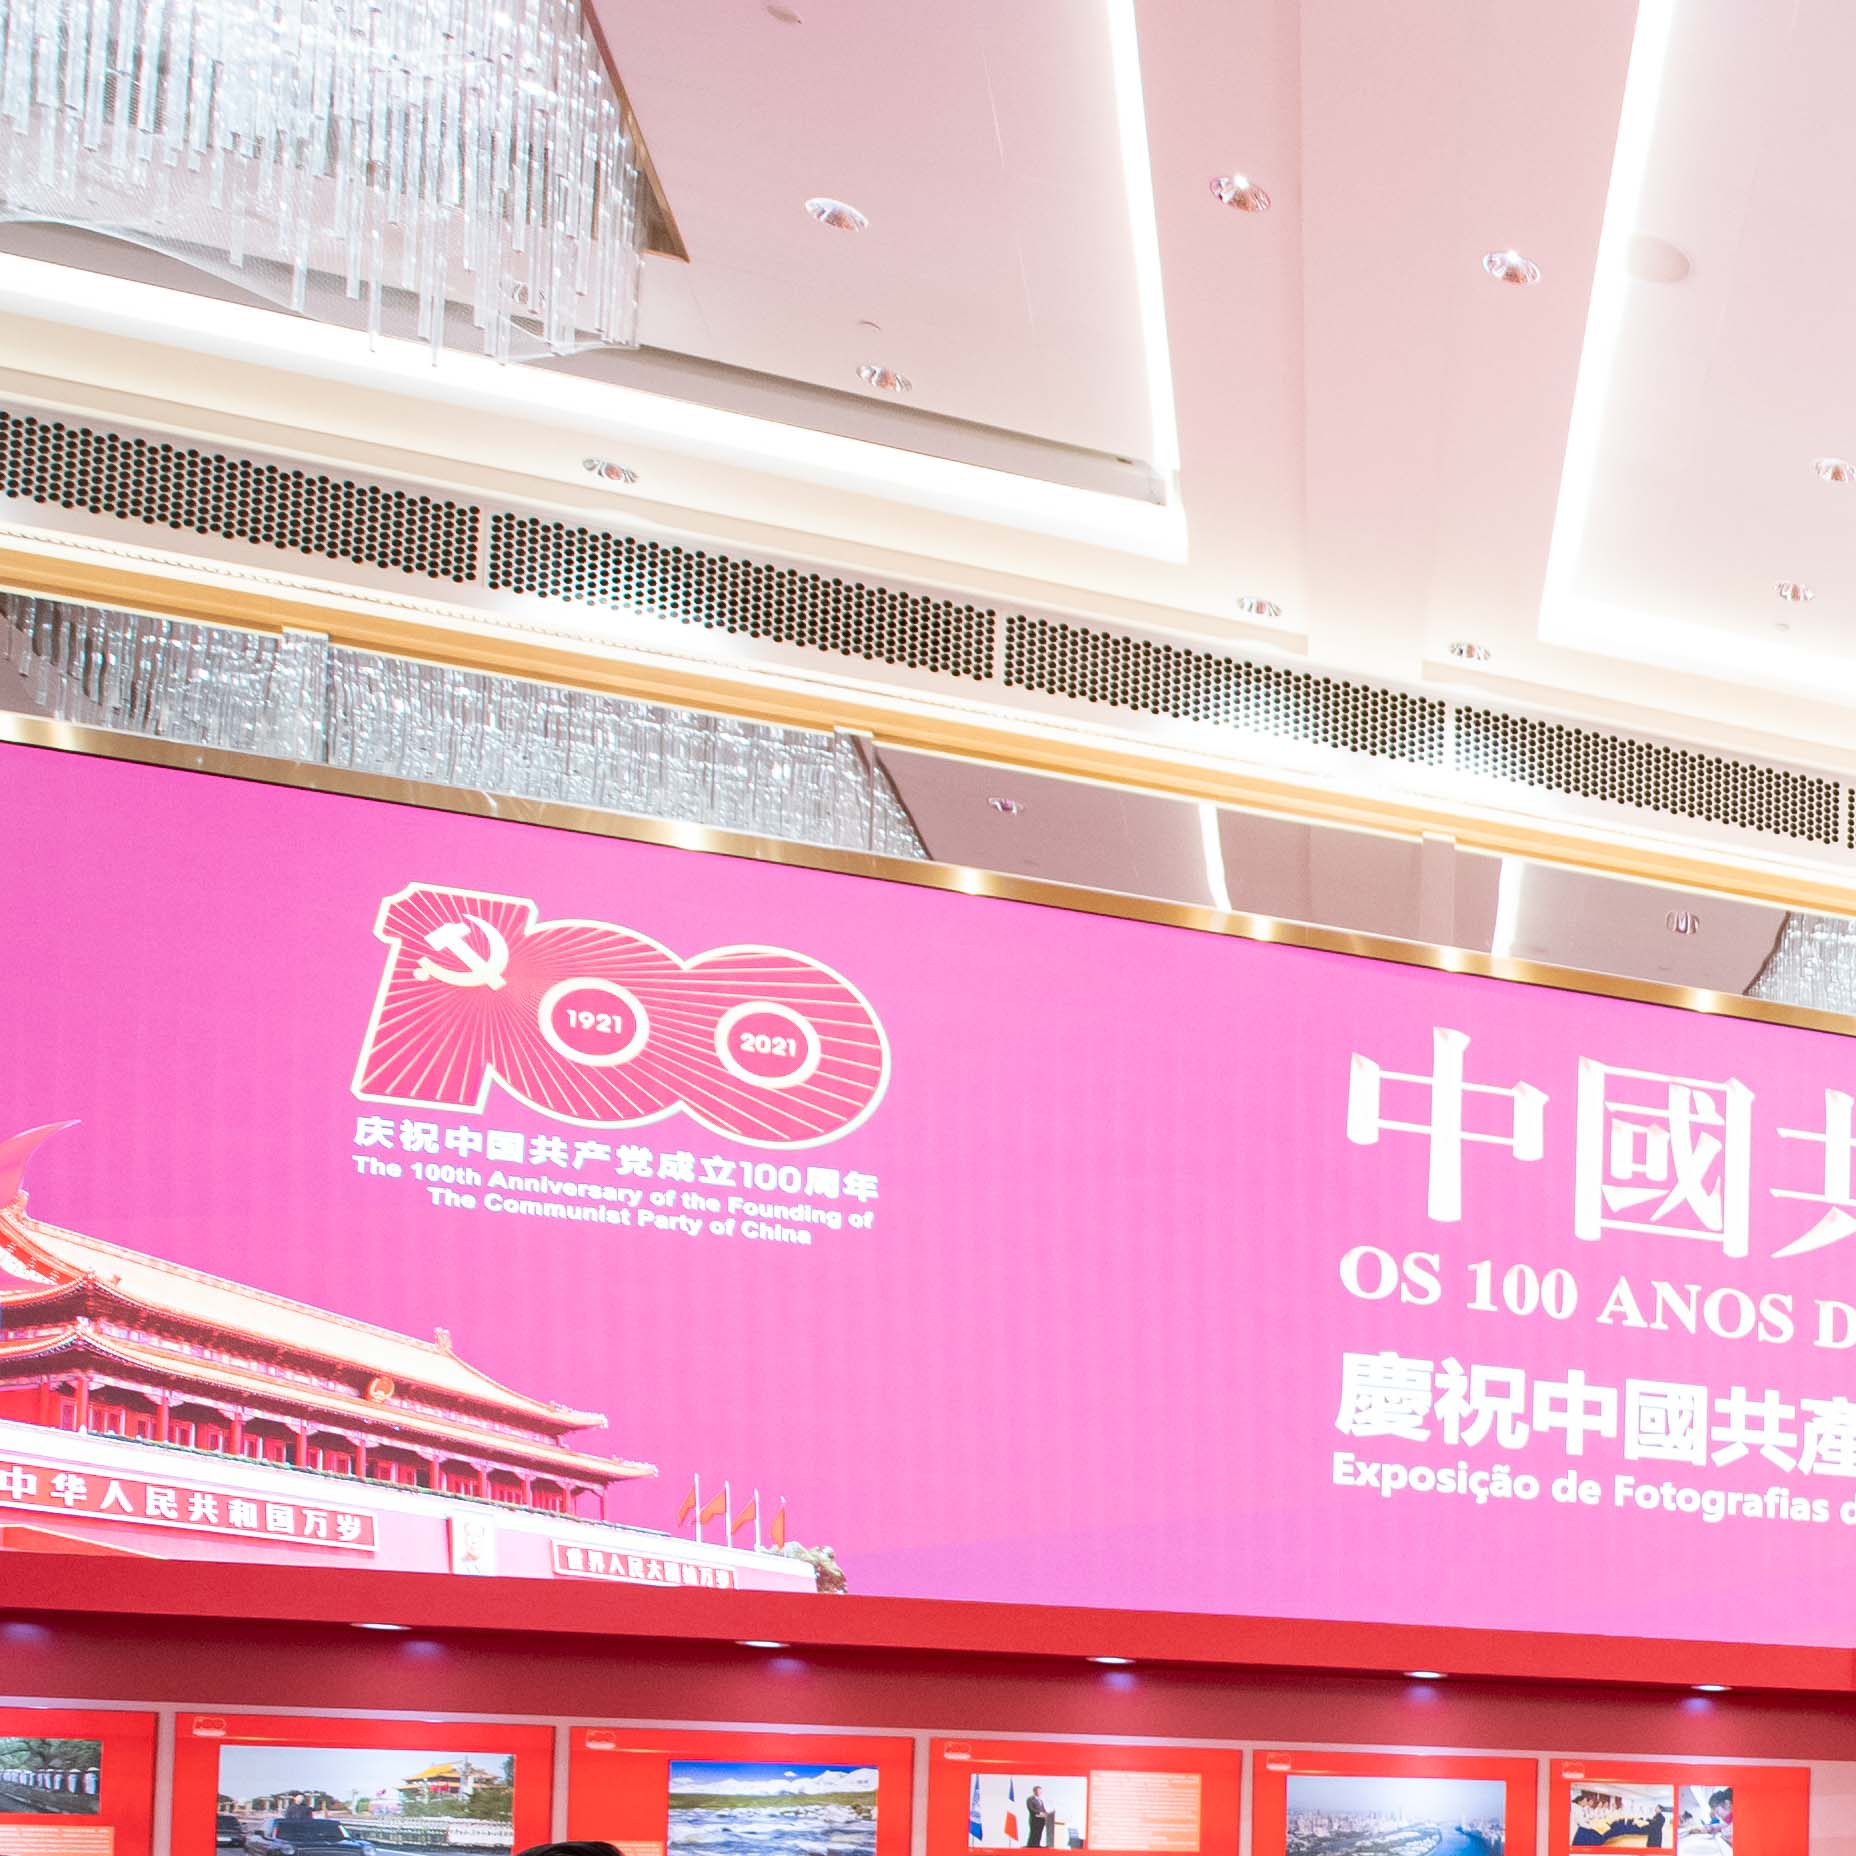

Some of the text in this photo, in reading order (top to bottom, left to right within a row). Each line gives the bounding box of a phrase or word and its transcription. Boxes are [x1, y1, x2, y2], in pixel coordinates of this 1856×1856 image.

[566, 1008, 624, 1035] 1921
[739, 1031, 798, 1059] 2021
[352, 1155, 874, 1230] The 100th Anniversary of the Founding of
[353, 1115, 879, 1203] 庆祝中国共产党成立100周年
[426, 1186, 812, 1246] The Communist Party of China
[1339, 1245, 1442, 1305] OS
[1467, 1260, 1578, 1320] 100
[1596, 1276, 1794, 1344] ANOS
[0, 1466, 362, 1541] 中华人民共和国万岁
[1332, 1451, 1540, 1505] Exposição
[1551, 1469, 1602, 1505] de
[1614, 1474, 1830, 1523] Fotografias
